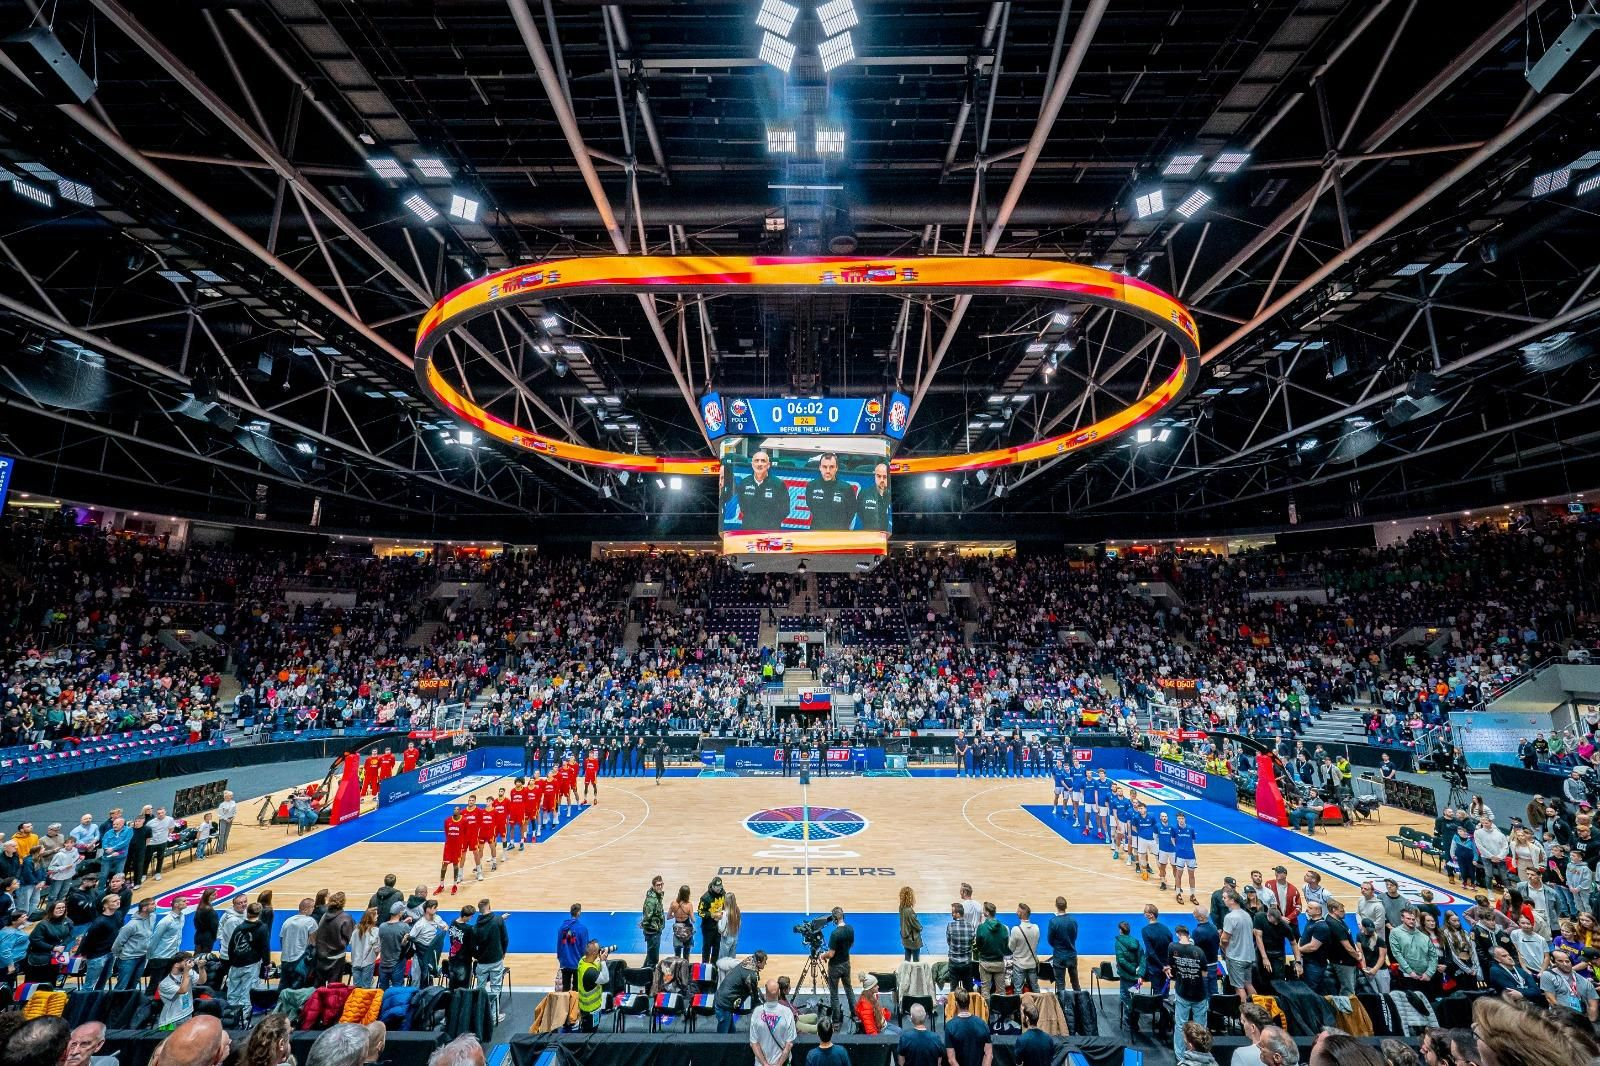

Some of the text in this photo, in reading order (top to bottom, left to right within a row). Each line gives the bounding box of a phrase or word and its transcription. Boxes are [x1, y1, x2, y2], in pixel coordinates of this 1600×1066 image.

[772, 406, 782, 423] 0
[787, 402, 823, 414] 06:02
[828, 406, 839, 423] 0
[737, 423, 744, 431] 0
[870, 423, 876, 431] 0
[428, 757, 466, 778] TIPOS BET
[1163, 764, 1187, 779] TIPOS
[1188, 770, 1205, 785] BET
[717, 866, 897, 876] QUALIFIERS
